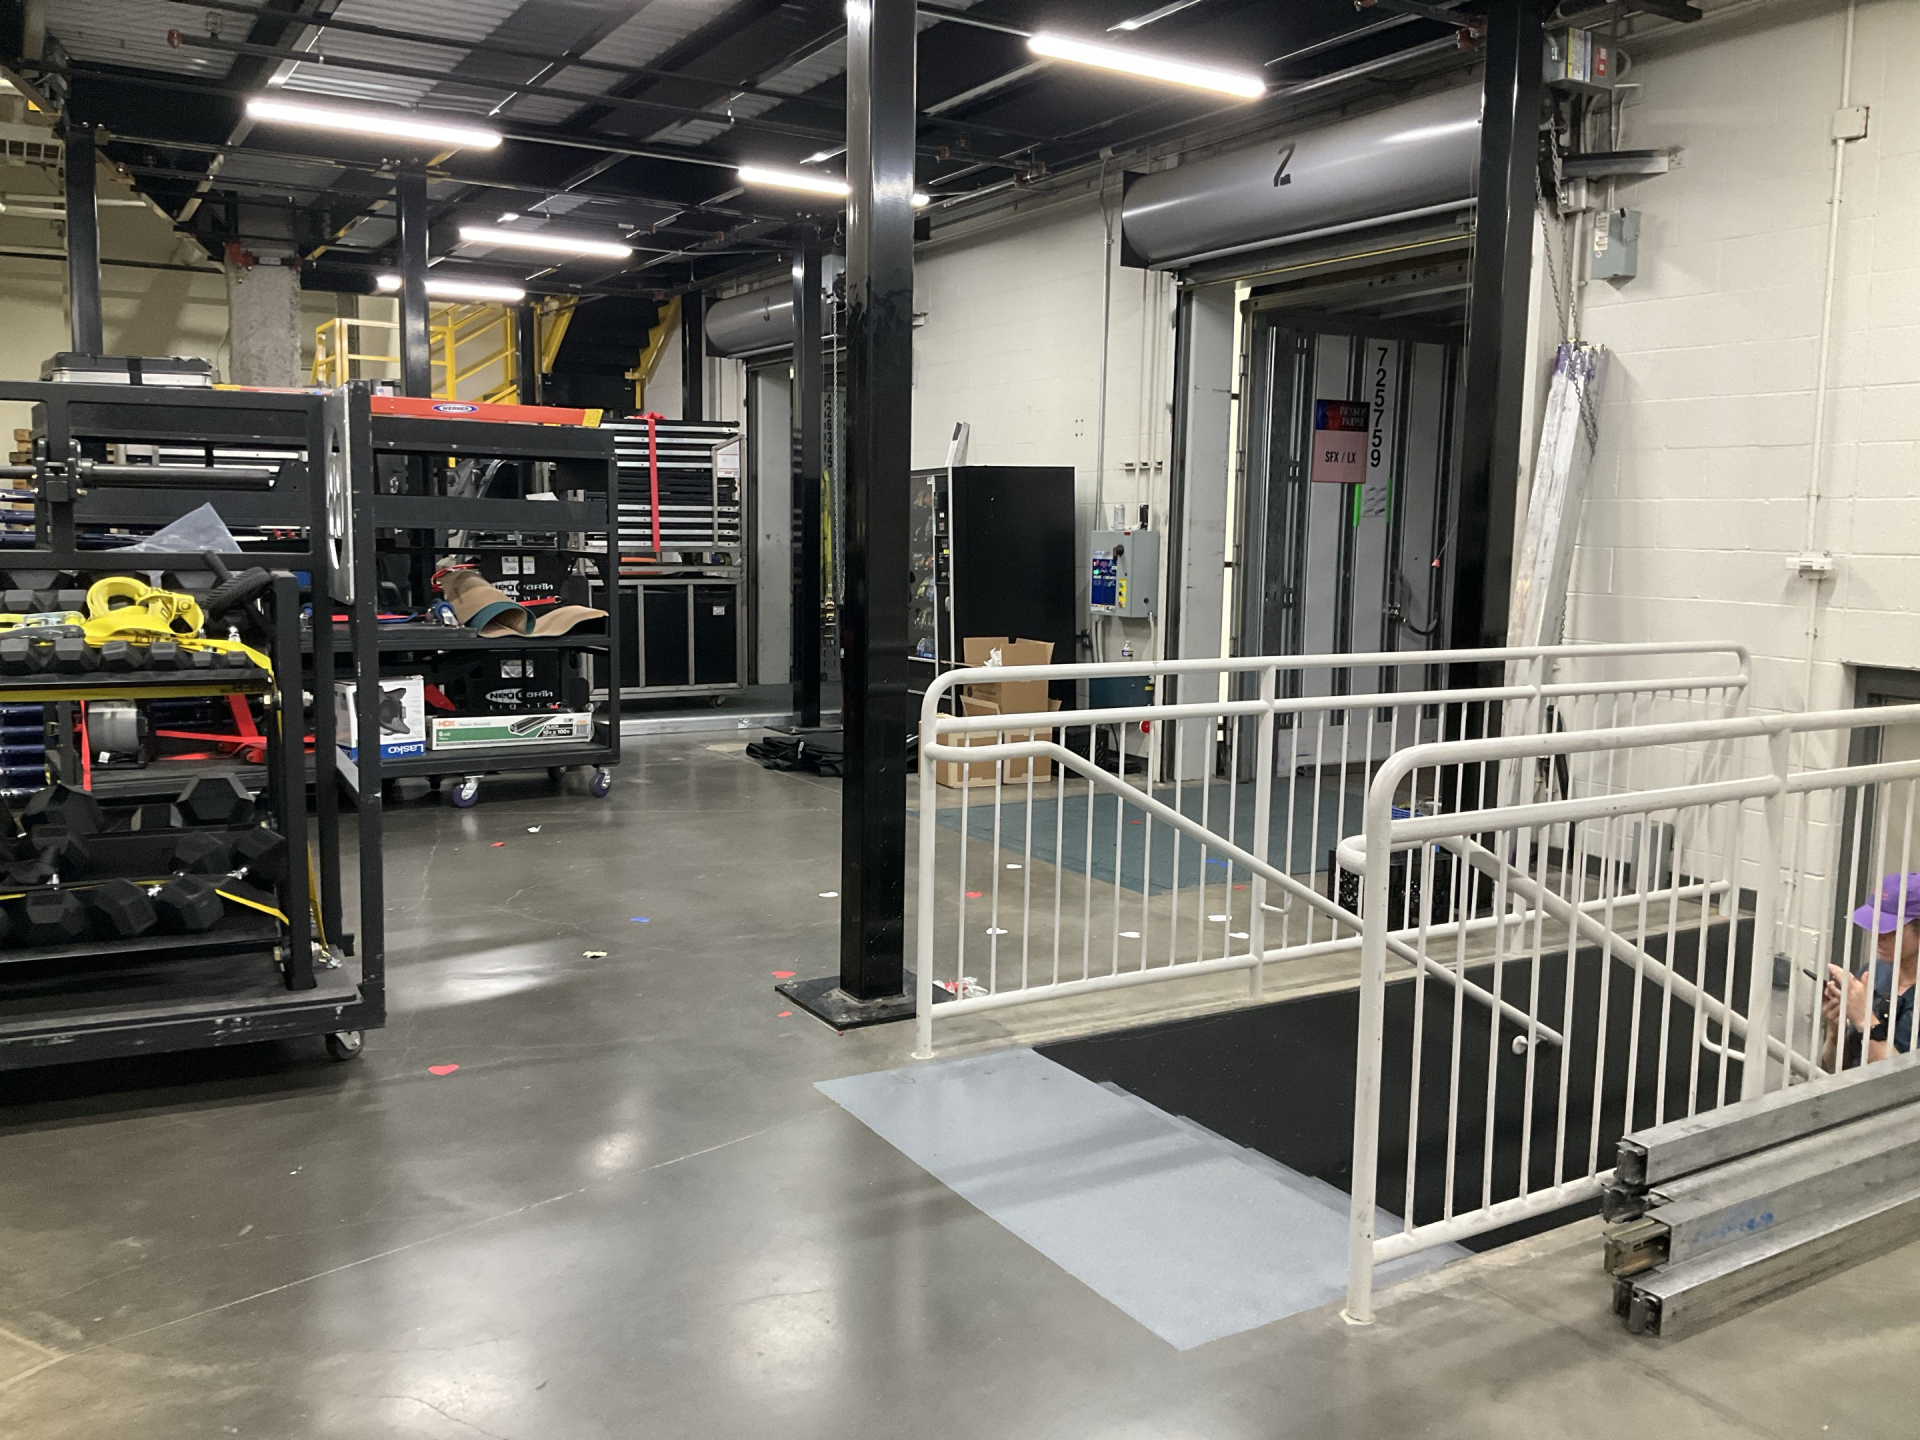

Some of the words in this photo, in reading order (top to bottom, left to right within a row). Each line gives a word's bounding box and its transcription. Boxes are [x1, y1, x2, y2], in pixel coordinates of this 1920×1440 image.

[1273, 142, 1296, 188] 2
[1370, 347, 1388, 467] 725759
[1325, 451, 1339, 463] SFX
[1347, 452, 1356, 464] LX
[388, 743, 424, 755] Lasko
